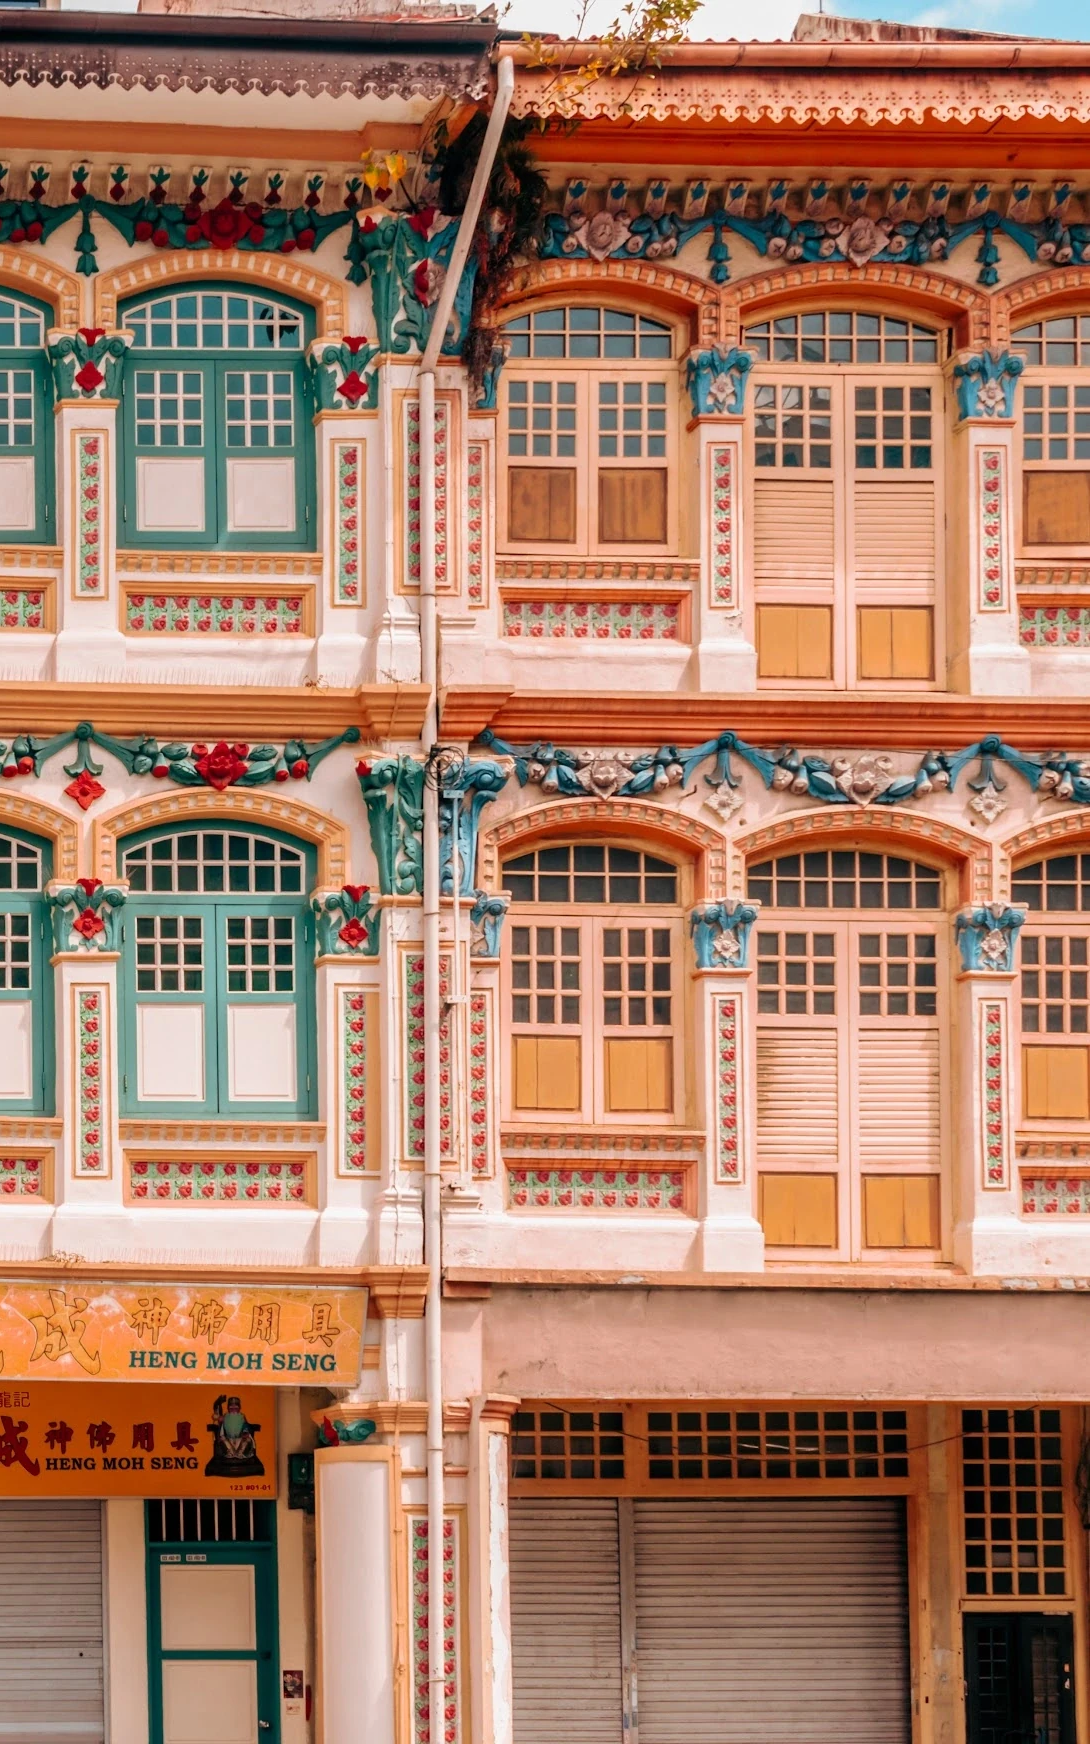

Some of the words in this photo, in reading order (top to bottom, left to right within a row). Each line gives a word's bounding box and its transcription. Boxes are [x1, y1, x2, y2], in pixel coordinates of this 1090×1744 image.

[129, 1351, 198, 1369] HENG
[206, 1351, 263, 1371] MOH
[271, 1353, 337, 1373] SENG
[45, 1457, 97, 1471] HENG
[102, 1457, 145, 1471] MOH
[150, 1456, 199, 1470] SENG
